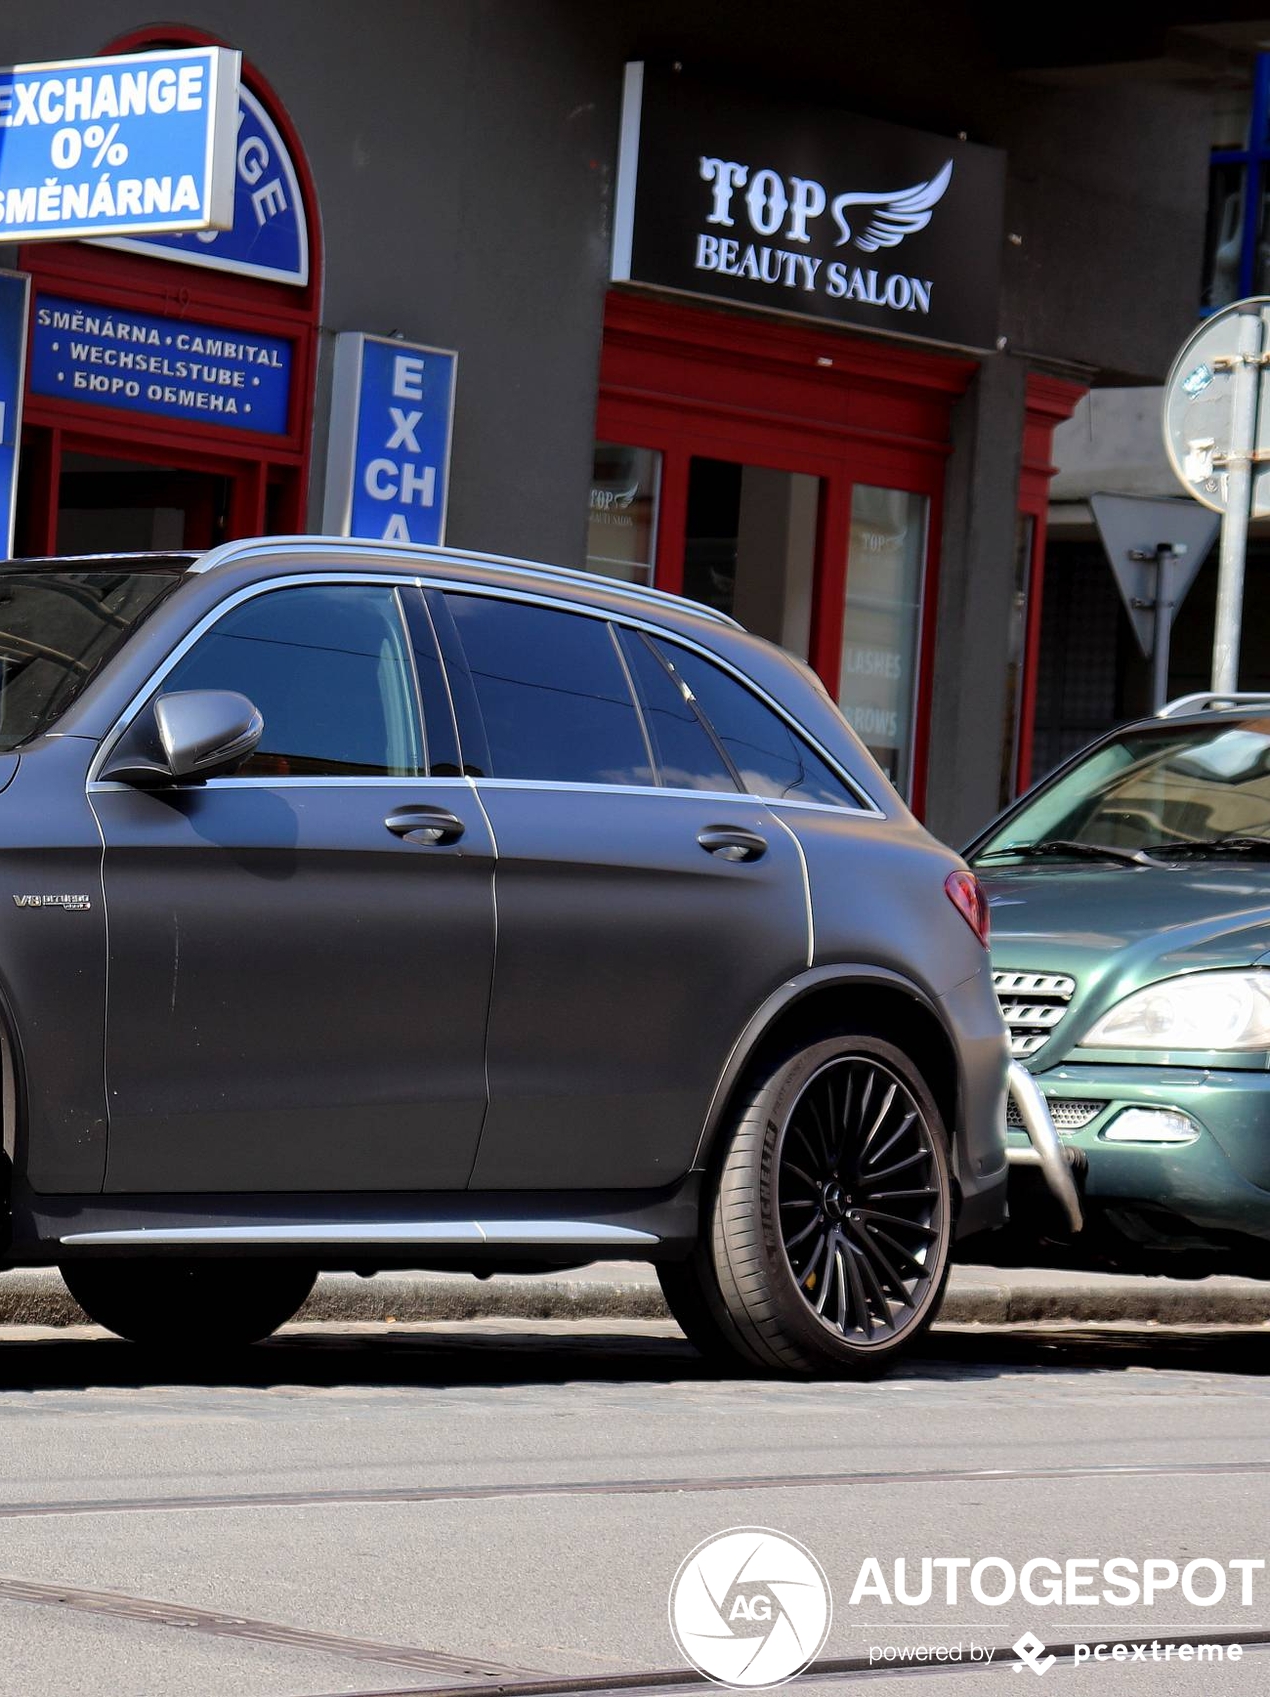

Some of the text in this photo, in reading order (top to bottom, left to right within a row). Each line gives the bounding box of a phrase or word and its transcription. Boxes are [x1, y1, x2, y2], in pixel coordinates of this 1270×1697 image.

[50, 123, 128, 170] 0%
[699, 156, 827, 244] TOP
[694, 233, 934, 315] BEAUTY SALON
[38, 309, 283, 368] SMĚNÁRNA CAMBITAL
[70, 342, 245, 388] WECHSELSTUBE
[73, 371, 238, 414] БЮРО ОБМЕНА
